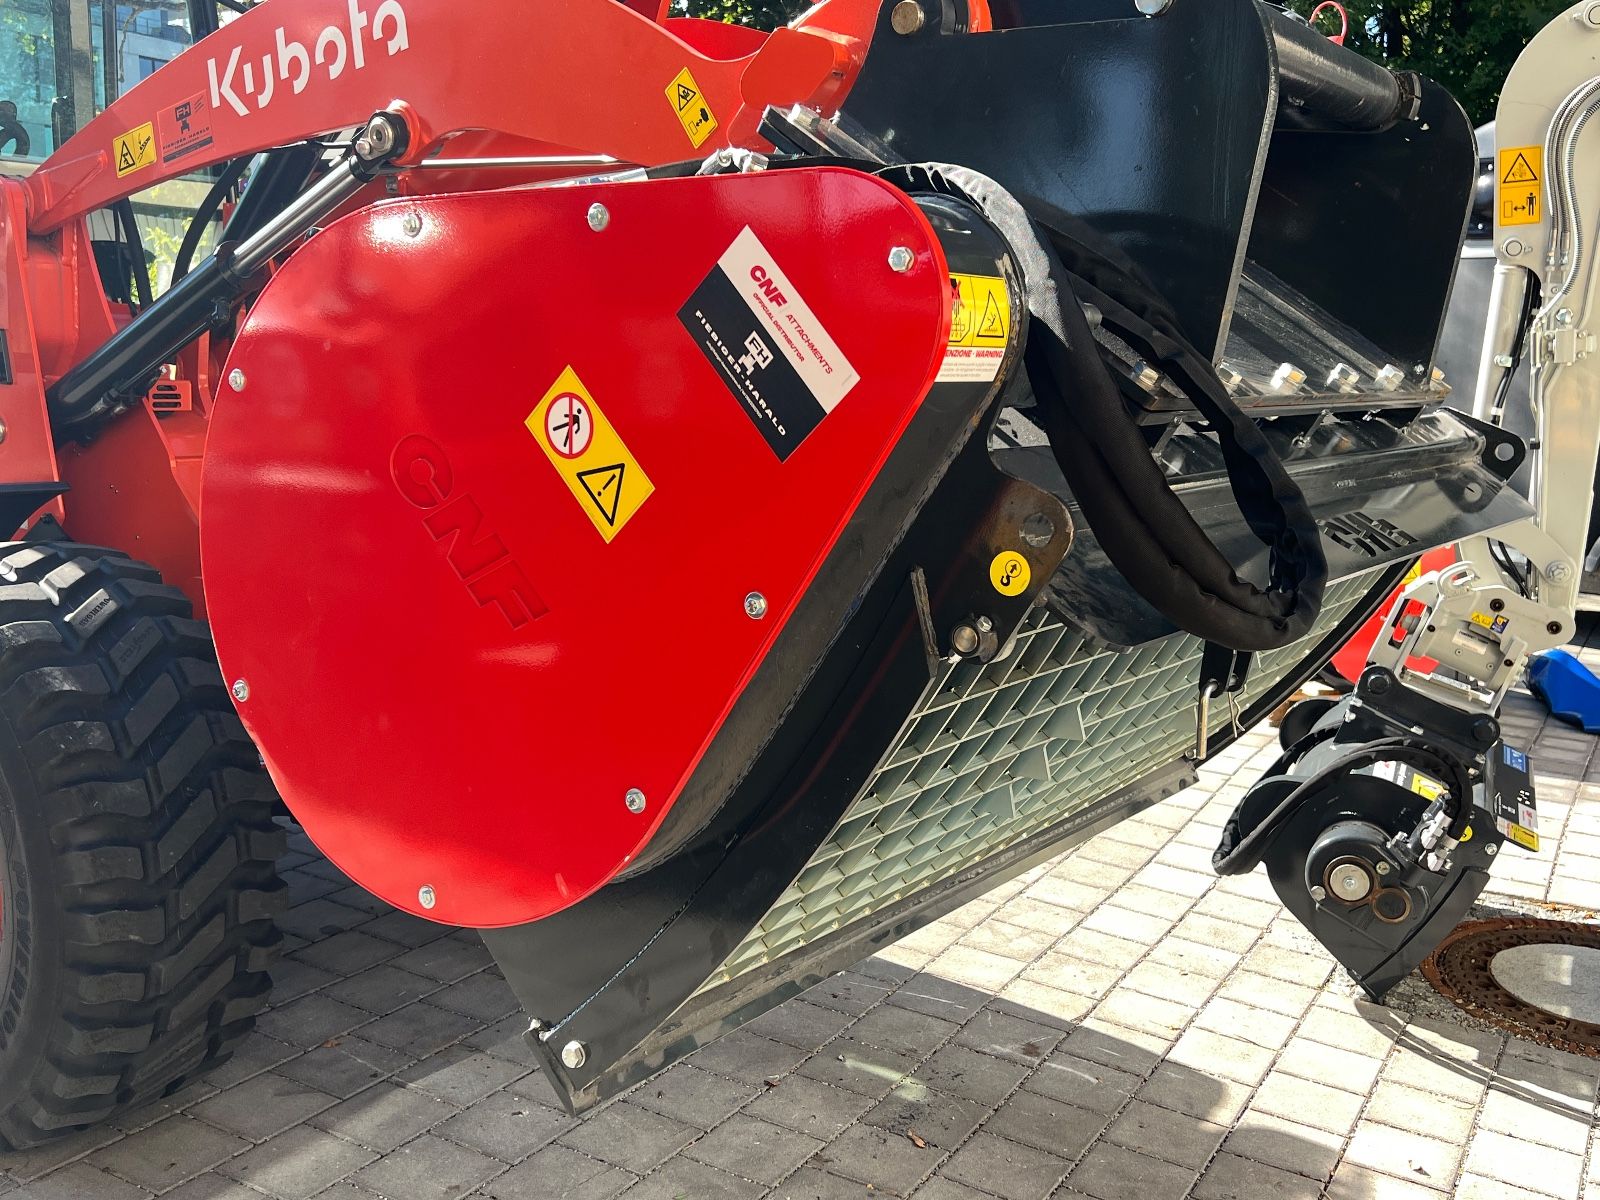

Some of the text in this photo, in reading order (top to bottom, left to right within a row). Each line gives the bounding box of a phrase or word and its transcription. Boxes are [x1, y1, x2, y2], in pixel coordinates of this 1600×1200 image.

[207, 0, 409, 117] Kubota
[750, 265, 833, 375] CNF ATTACHMENTS
[753, 292, 805, 363] OFFICIAL DISTRIBUTOR
[945, 349, 1004, 358] ENZIONE WARNING
[389, 432, 551, 630] CNF
